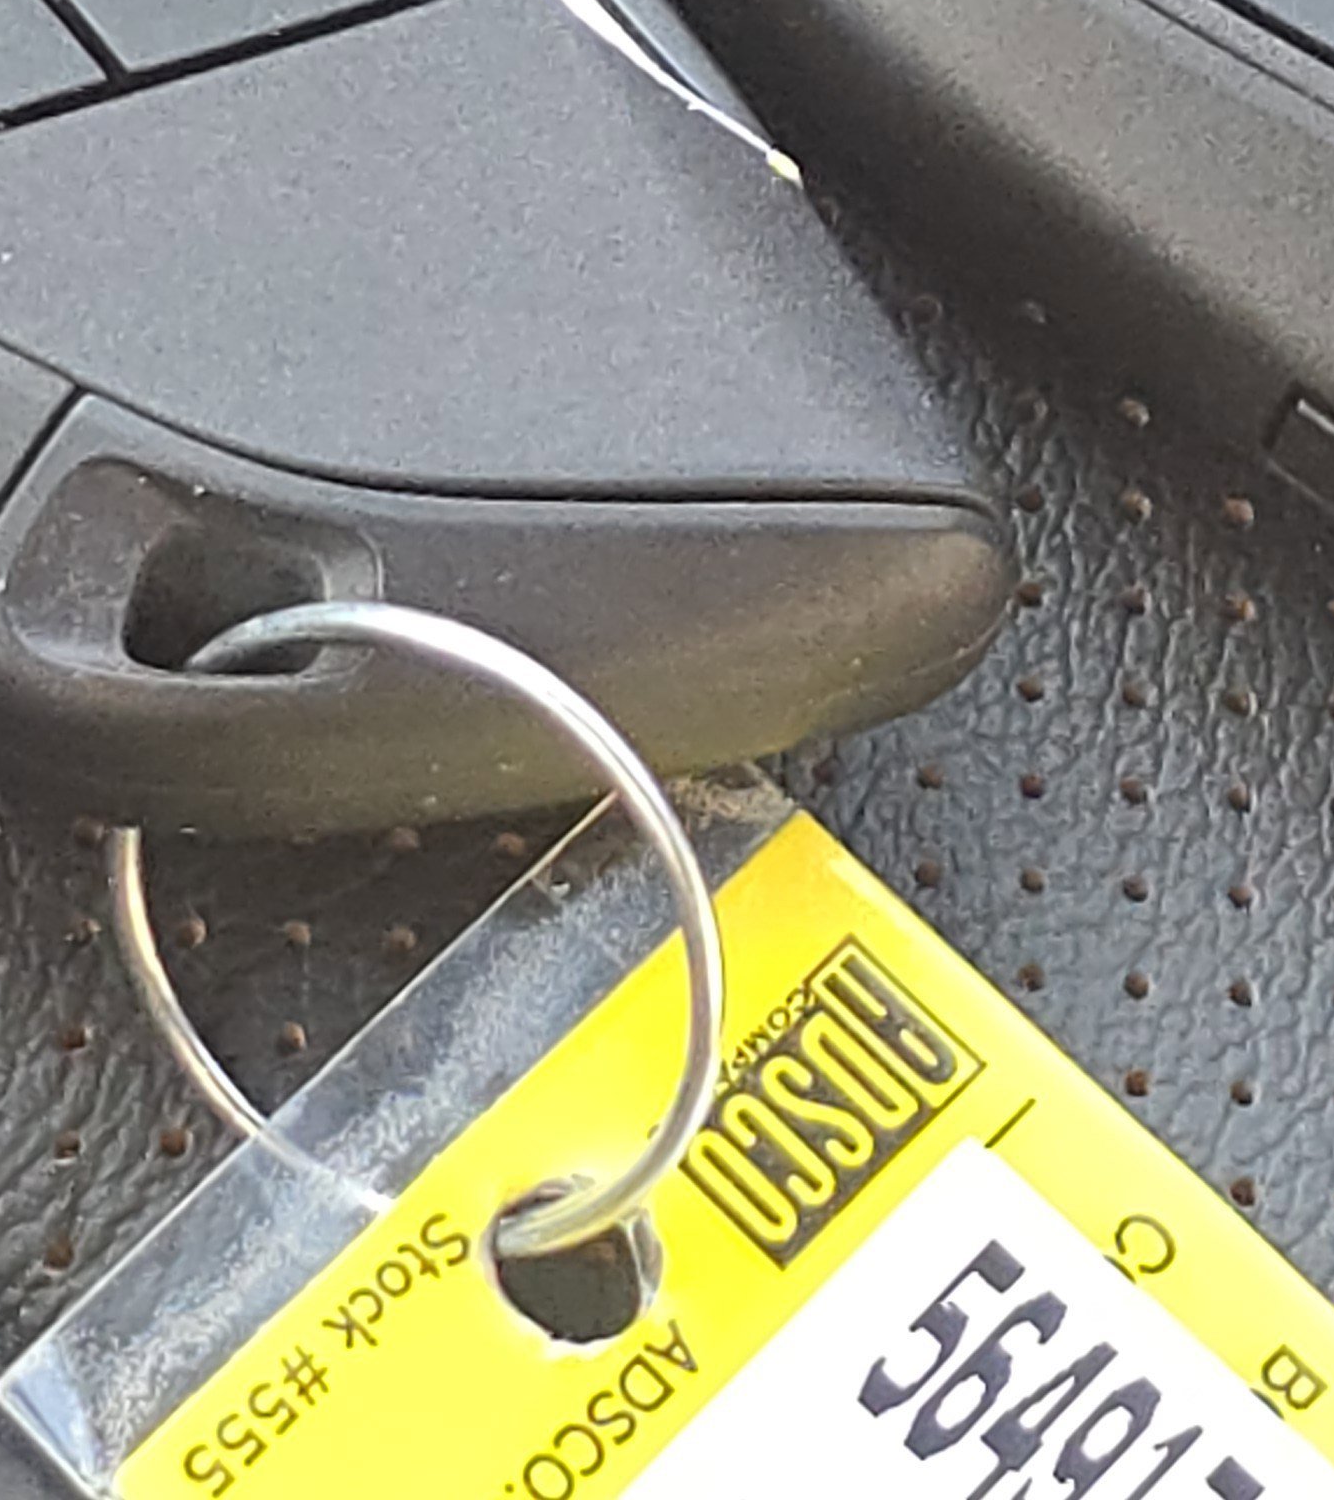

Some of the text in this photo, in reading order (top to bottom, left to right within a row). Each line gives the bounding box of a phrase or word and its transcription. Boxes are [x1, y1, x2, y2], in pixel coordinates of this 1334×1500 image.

[687, 950, 961, 1244] ADSCO
[182, 1212, 471, 1498] Stock #555
[857, 1238, 1266, 1500] 5649
